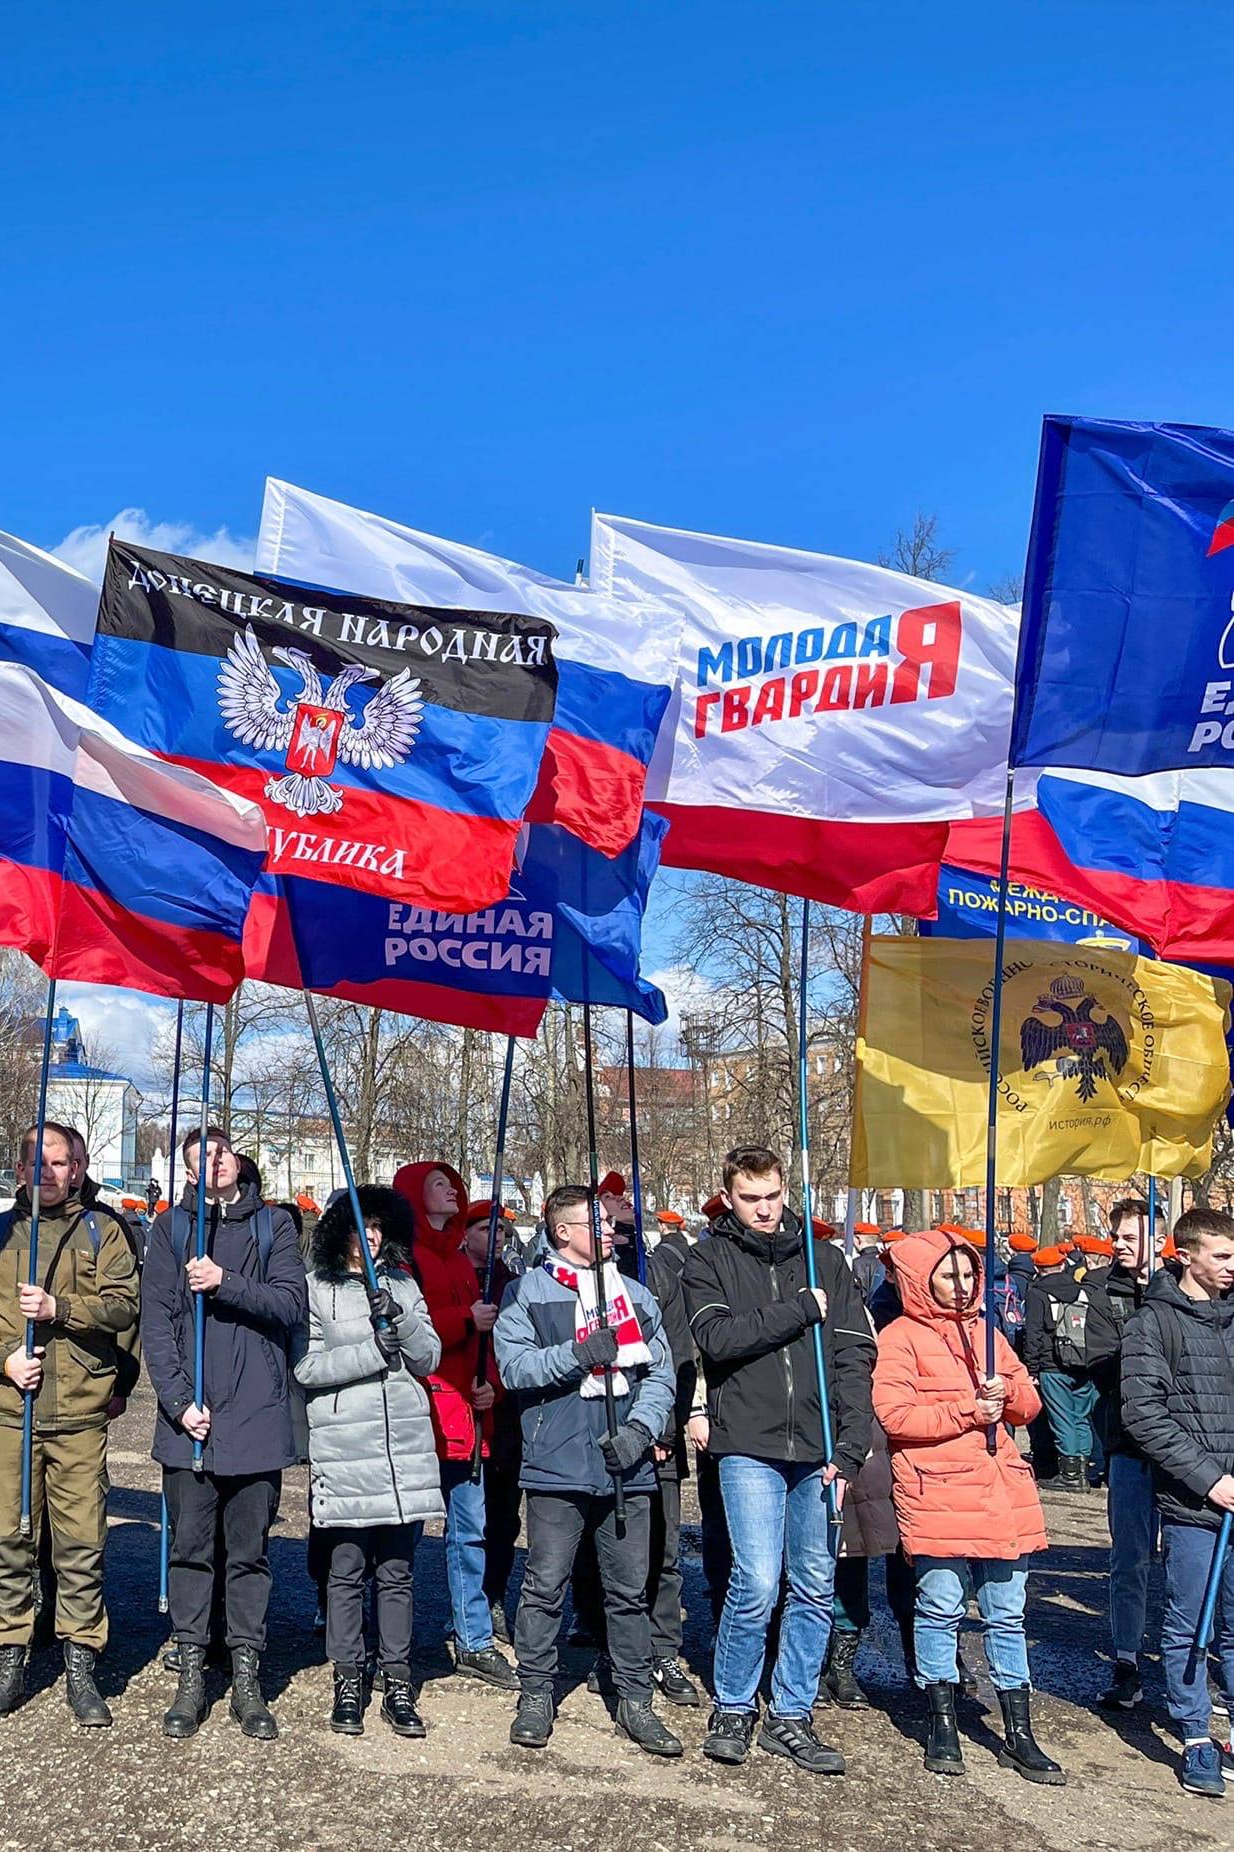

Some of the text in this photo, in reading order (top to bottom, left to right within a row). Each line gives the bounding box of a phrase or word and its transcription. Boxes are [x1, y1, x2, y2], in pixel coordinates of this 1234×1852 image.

[128, 560, 547, 666] ДОНЕЦКАЯ НАРОДНАЯ
[266, 826, 407, 879] УБЛИКА
[388, 903, 553, 939] ЕДИНАЯ
[385, 938, 551, 976] РОССИЯ
